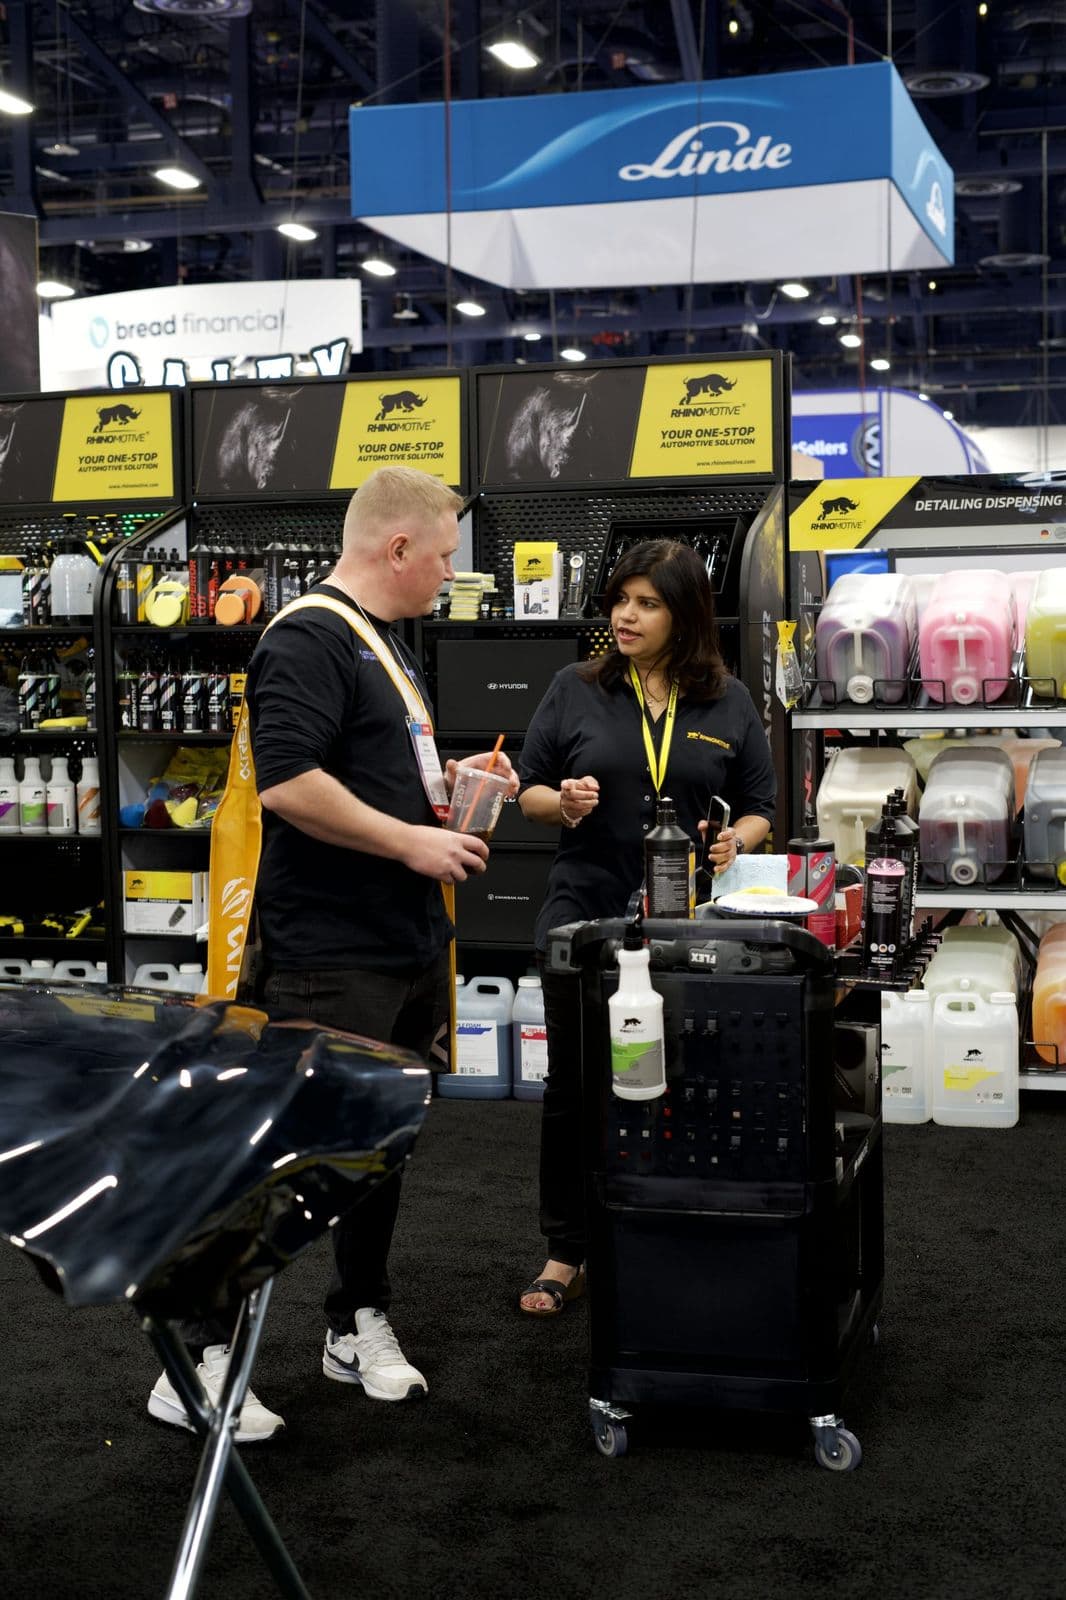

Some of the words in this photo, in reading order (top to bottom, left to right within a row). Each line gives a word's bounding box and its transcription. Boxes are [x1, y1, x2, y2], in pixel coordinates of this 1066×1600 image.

[618, 121, 792, 181] Linde
[115, 315, 177, 340] bread
[183, 308, 285, 334] financial
[661, 429, 692, 440] YOUR
[695, 426, 755, 438] ONE-STOP
[358, 443, 387, 453] YOUR
[389, 441, 444, 452] ONE-STOP
[660, 440, 713, 449] AUTOMOTIVE
[715, 438, 755, 446] SOLUTION
[79, 455, 105, 465] YOUR
[107, 452, 158, 463] ONE-STOP
[357, 454, 405, 462] AUTOMOTIVE
[407, 452, 444, 460] SOLUTION
[78, 465, 122, 473] AUTOMOTIVE
[915, 498, 983, 512] DETAILING
[985, 494, 1063, 509] DISPENSING
[763, 610, 772, 749] ANGER
[690, 952, 717, 965] FLEX
